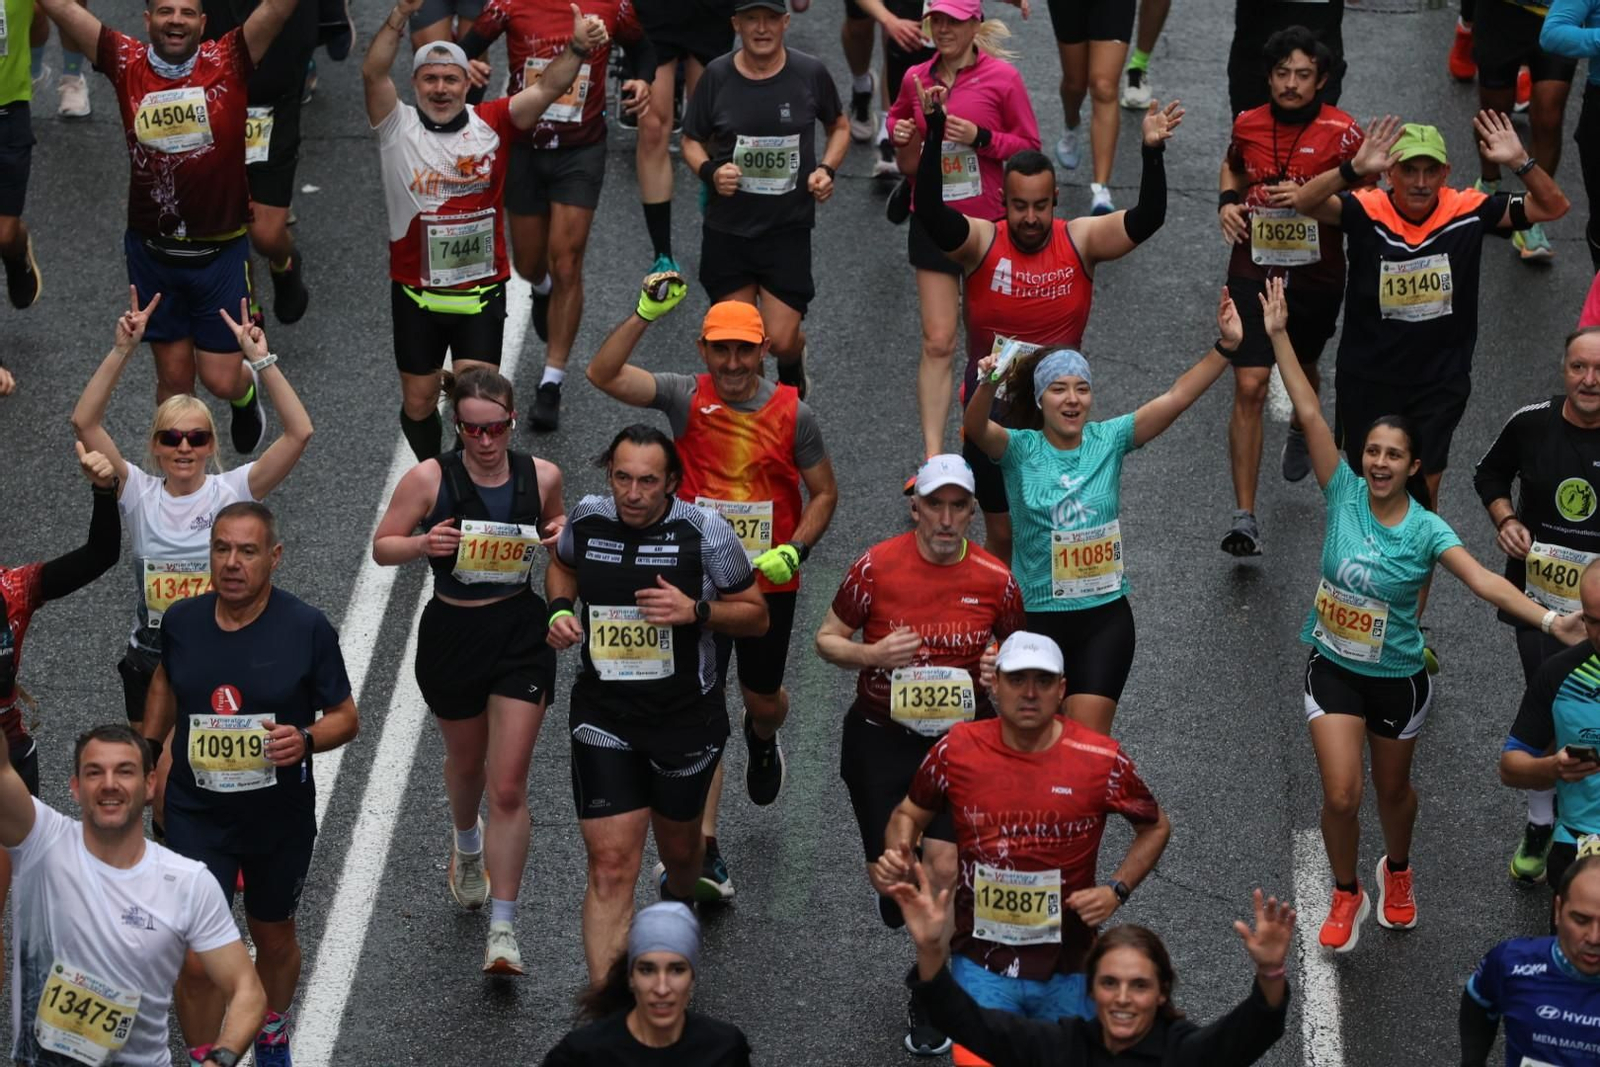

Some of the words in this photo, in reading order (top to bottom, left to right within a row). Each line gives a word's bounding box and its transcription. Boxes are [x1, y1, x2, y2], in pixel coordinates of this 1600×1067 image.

[140, 104, 196, 129] 14504
[743, 151, 786, 169] 9065
[1257, 222, 1306, 241] 13629
[439, 236, 480, 259] 7444
[1385, 272, 1441, 296] 13140
[468, 538, 525, 561] 11136
[1059, 541, 1113, 568] 11085
[1321, 597, 1373, 633] 11629
[597, 625, 658, 648] 12630
[898, 685, 962, 708] 13325
[196, 735, 262, 758] 10919
[1051, 786, 1072, 795] HOKA
[986, 809, 1060, 826] MEDIO
[980, 885, 1047, 913] 12887
[1511, 963, 1547, 976] HOKA
[49, 984, 122, 1033] 13475
[1532, 1032, 1558, 1047] MEIA
